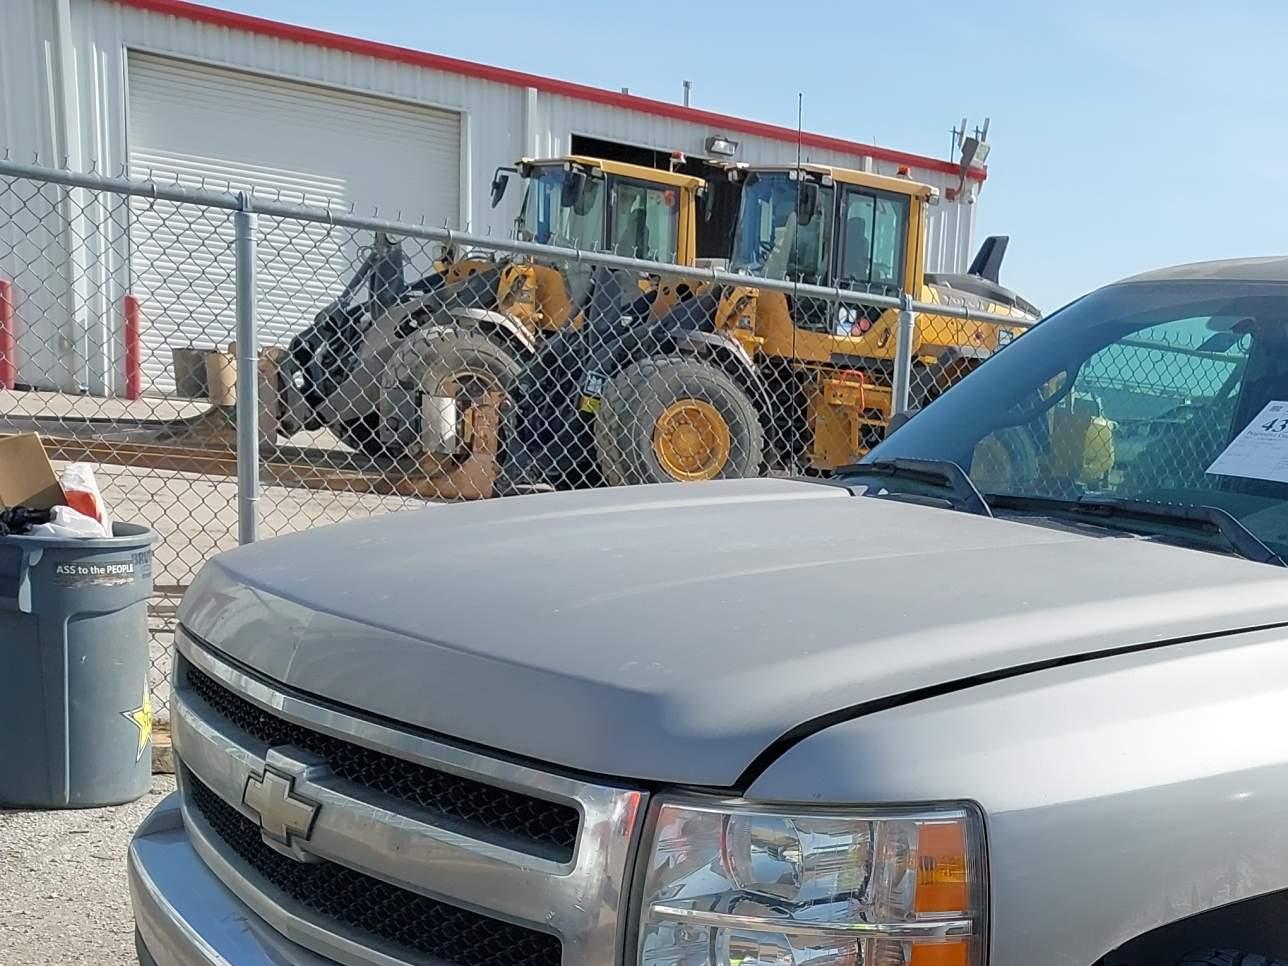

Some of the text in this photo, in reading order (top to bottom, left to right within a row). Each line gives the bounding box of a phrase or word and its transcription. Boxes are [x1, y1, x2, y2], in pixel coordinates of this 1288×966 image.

[56, 564, 76, 575] ASS
[78, 565, 88, 574] to
[90, 564, 106, 574] the
